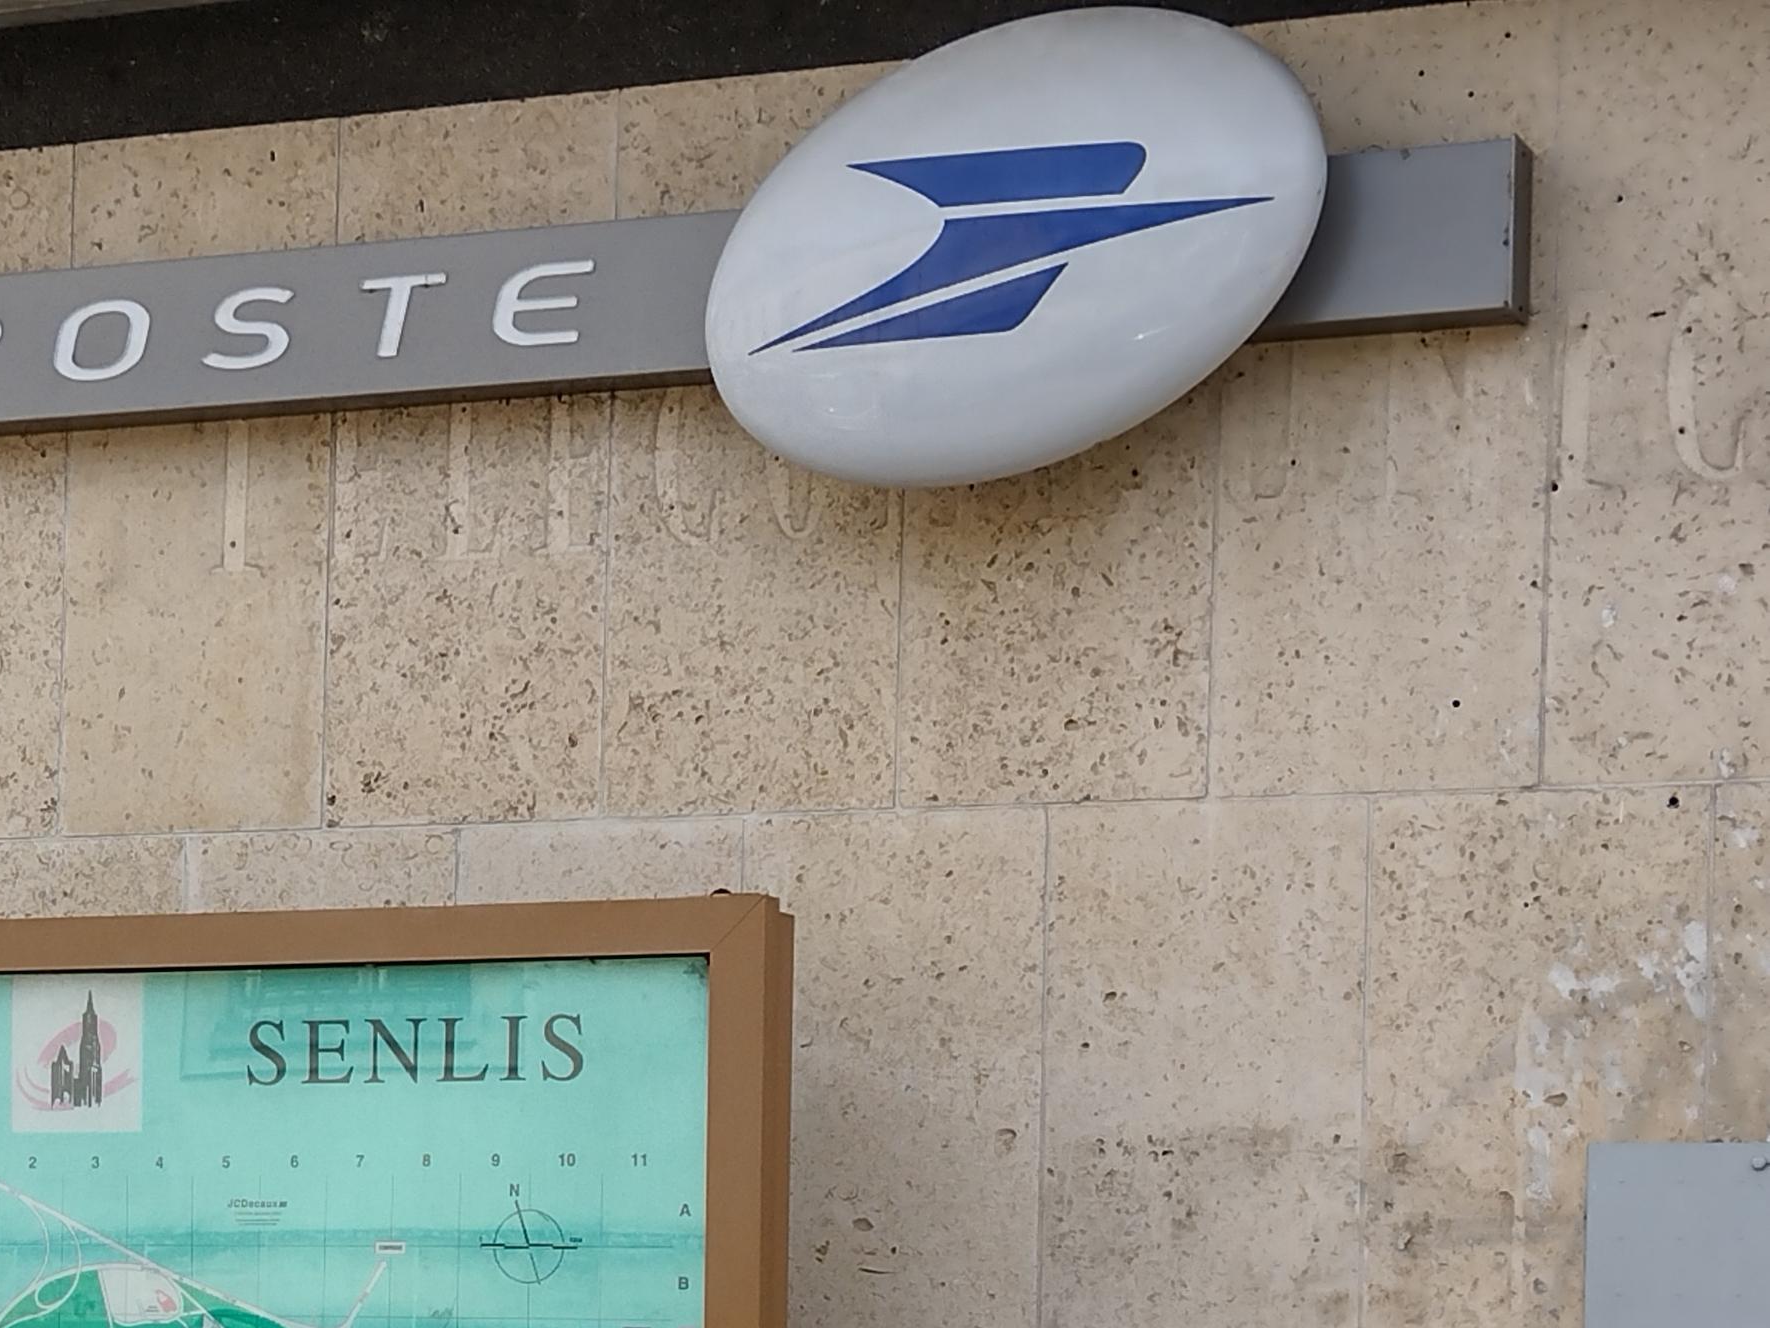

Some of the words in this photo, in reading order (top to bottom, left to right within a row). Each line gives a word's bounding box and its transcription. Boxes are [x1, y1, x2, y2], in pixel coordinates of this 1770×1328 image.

[247, 1015, 583, 1085] SENLIS
[28, 1156, 38, 1169] 2
[91, 1155, 100, 1169] 3
[155, 1156, 164, 1169] 4
[221, 1155, 231, 1169] 5
[290, 1154, 299, 1169] 6
[355, 1154, 365, 1168] 7
[422, 1153, 431, 1168] 8
[491, 1153, 501, 1167] 9
[558, 1153, 576, 1167] 10
[631, 1153, 647, 1167] 11
[509, 1183, 520, 1197] N
[227, 1199, 278, 1208] JCDecaux
[679, 1203, 692, 1217] A
[677, 1276, 689, 1291] B
